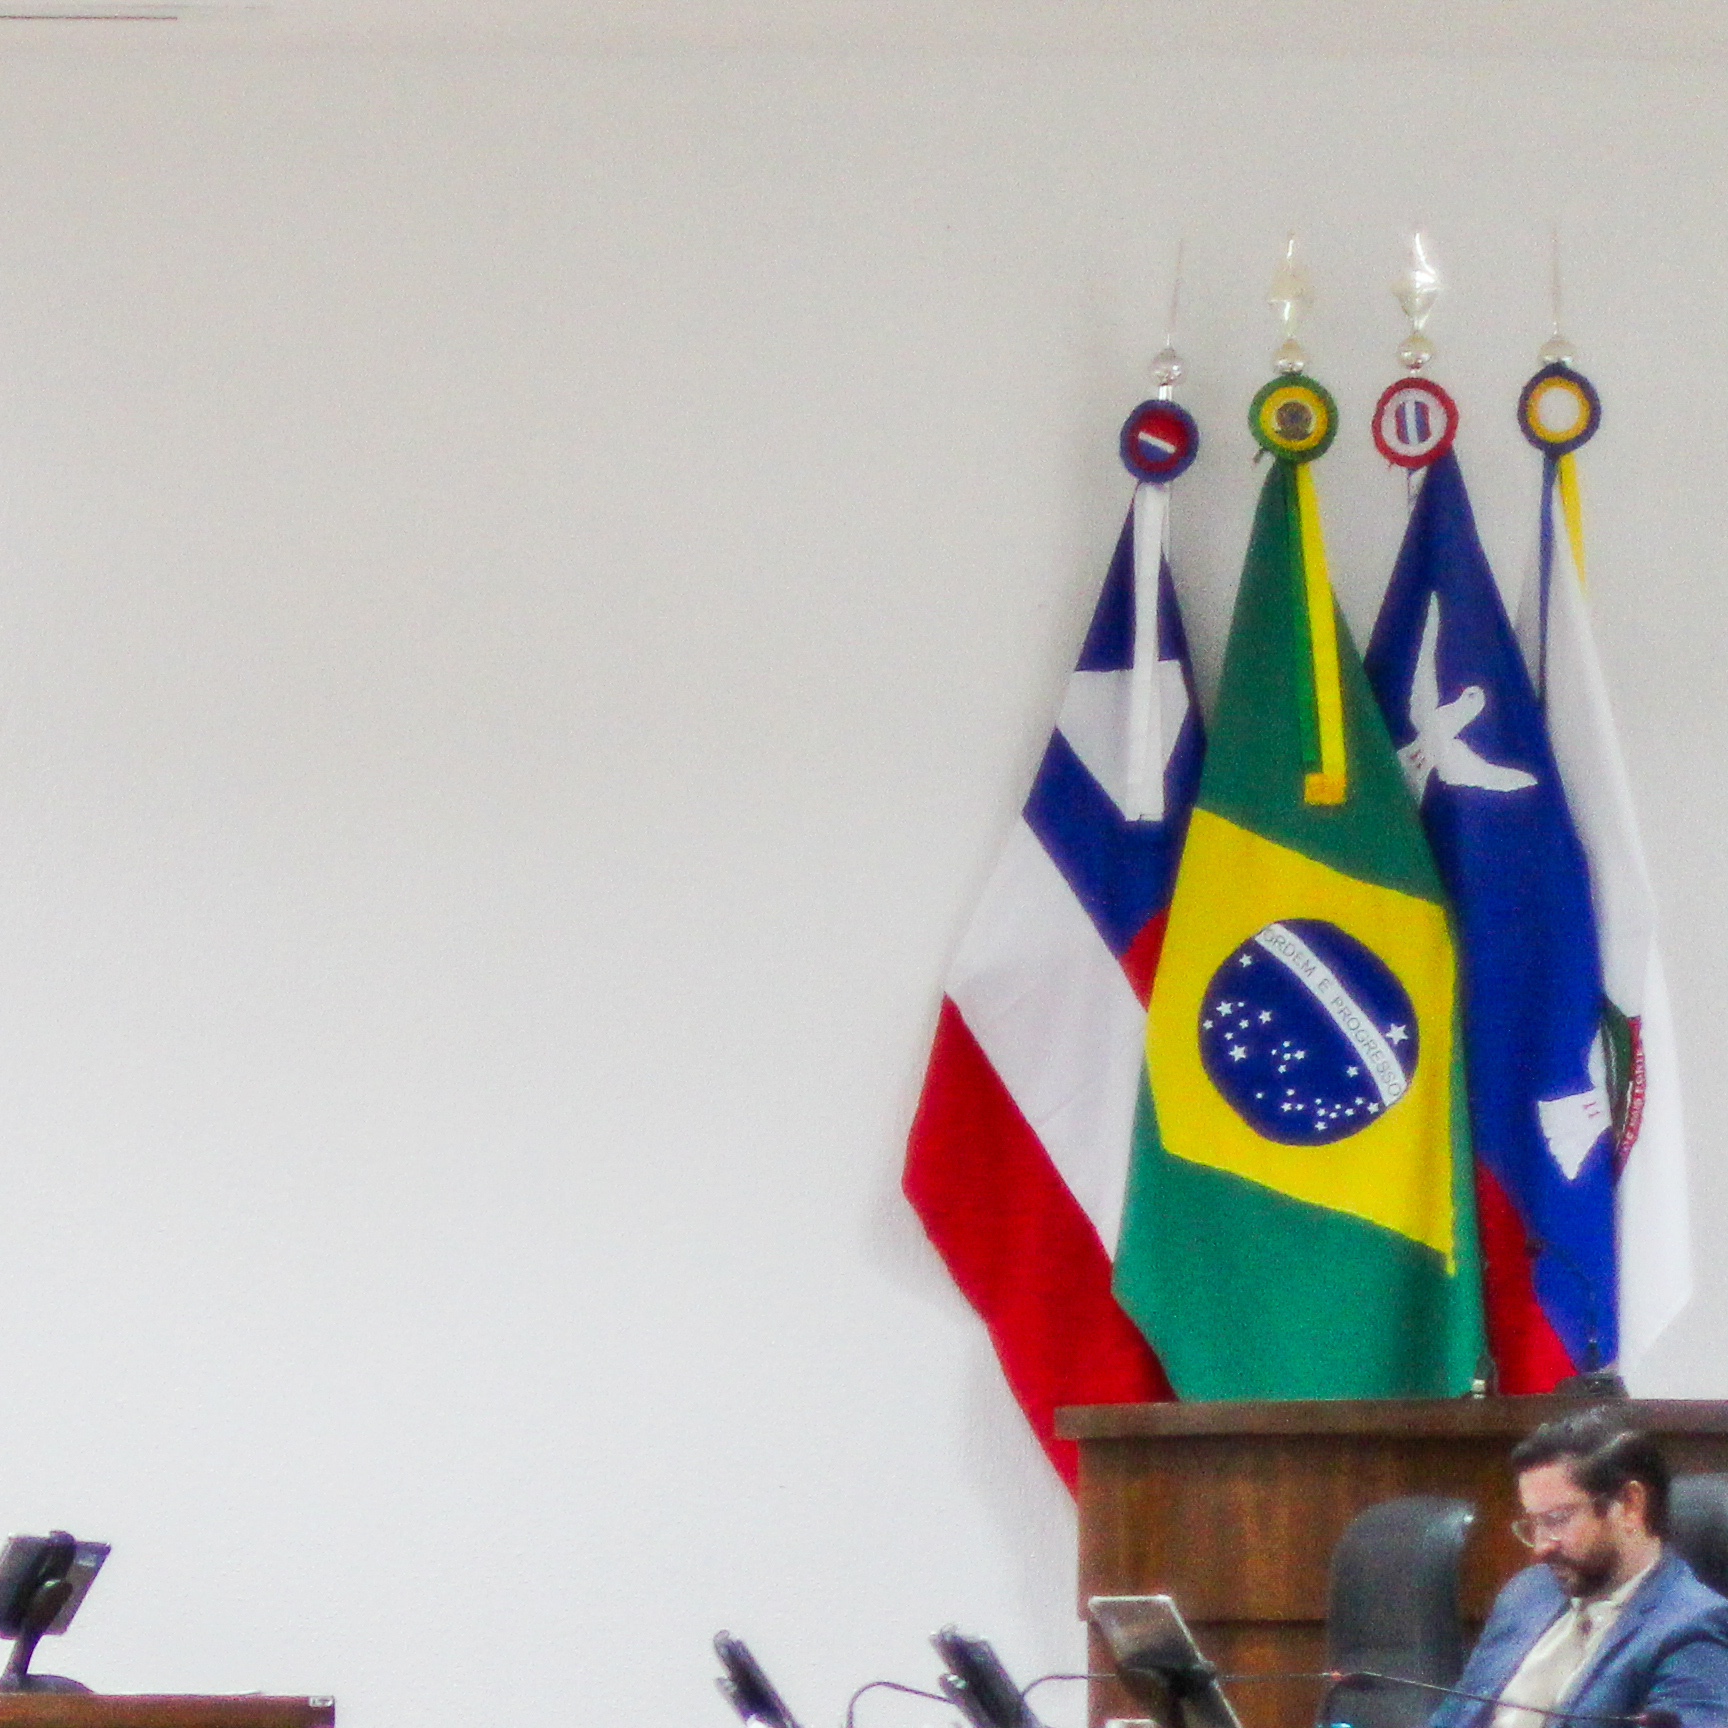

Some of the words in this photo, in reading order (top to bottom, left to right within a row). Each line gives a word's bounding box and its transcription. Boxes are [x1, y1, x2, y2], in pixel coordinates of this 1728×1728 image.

[1263, 928, 1317, 978] ORDEM
[1318, 977, 1331, 994] E
[1331, 996, 1402, 1097] PROGRESSO
